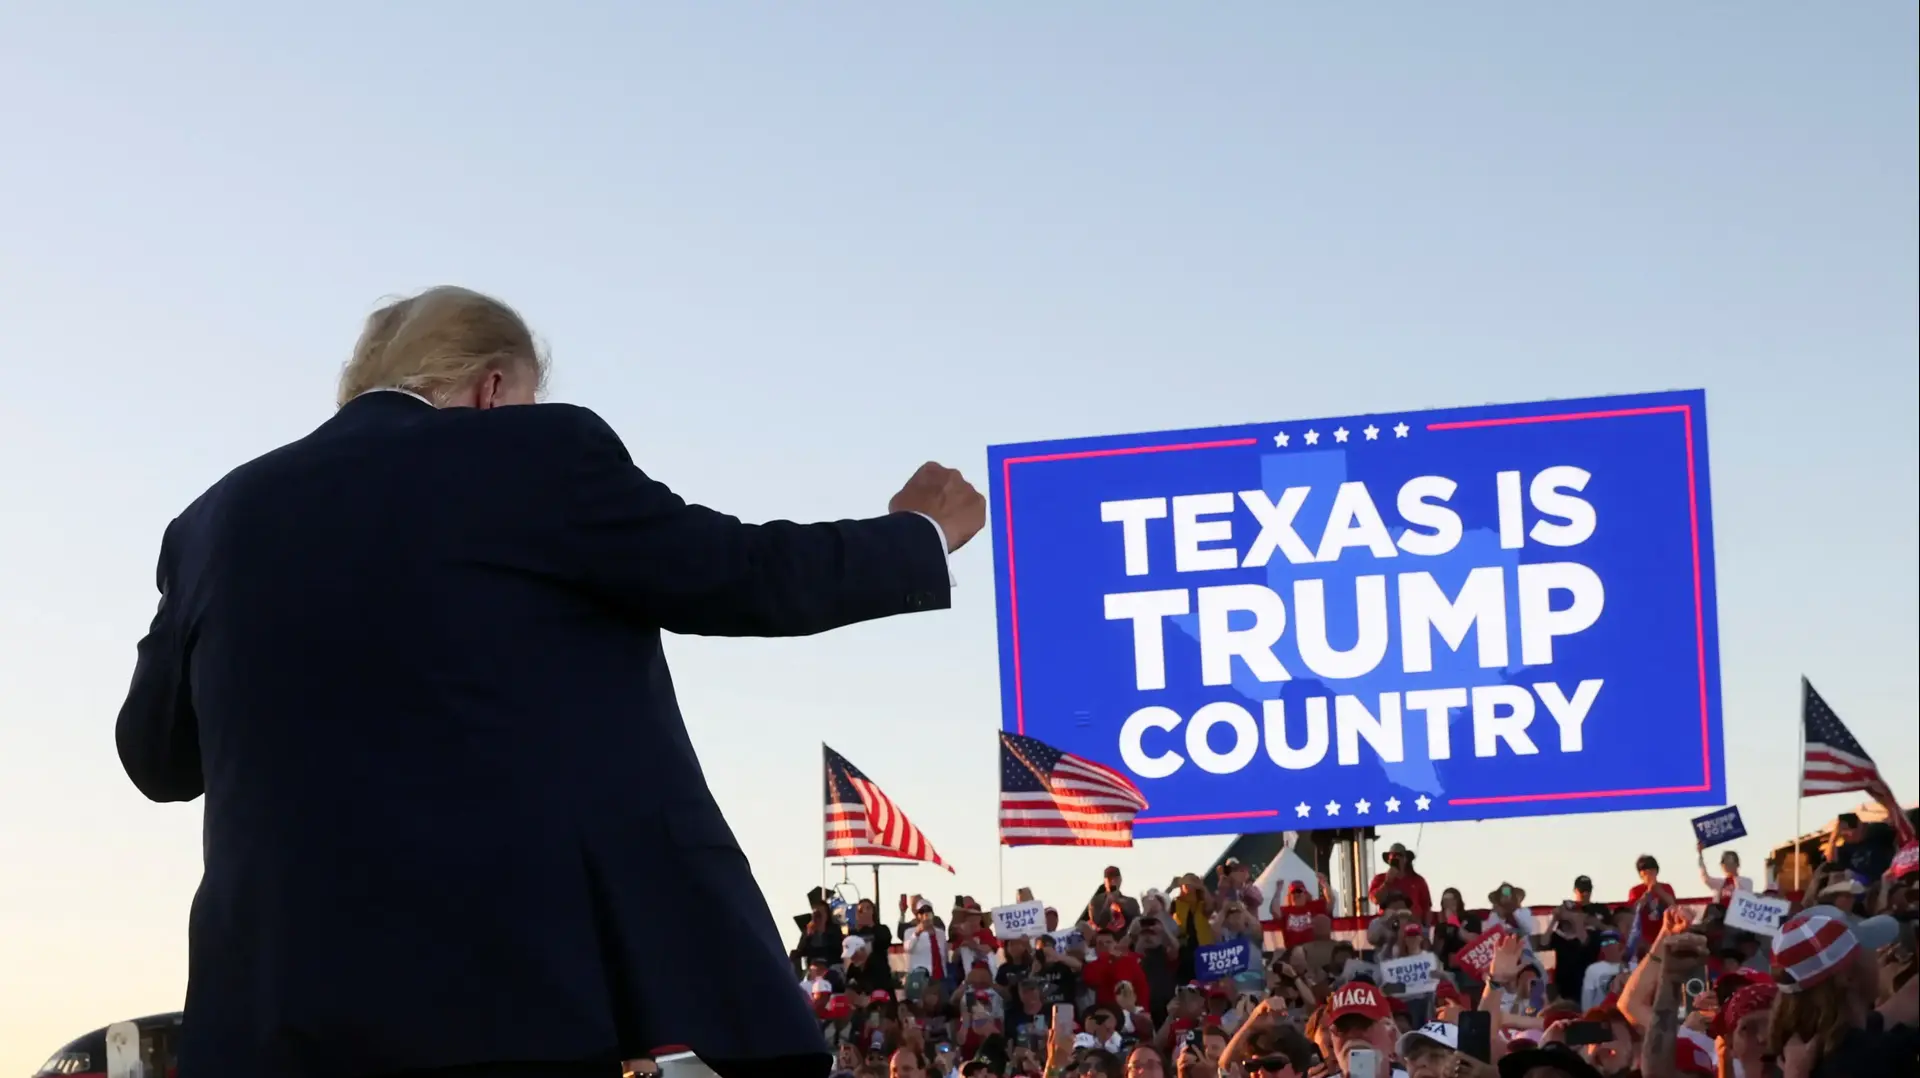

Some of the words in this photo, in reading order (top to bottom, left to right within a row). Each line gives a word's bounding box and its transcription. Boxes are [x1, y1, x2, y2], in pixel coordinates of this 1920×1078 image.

[1101, 475, 1463, 576] TEXAS
[1496, 465, 1597, 550] IS
[1103, 561, 1605, 691] TRUMP
[1118, 678, 1604, 779] COUNTRY
[1696, 812, 1736, 832] TRUMP
[997, 907, 1039, 921] TRUMP
[1738, 898, 1782, 914] TRUMP
[1005, 917, 1035, 929] 2024
[1740, 908, 1772, 923] 2024
[1200, 945, 1244, 963] TRUMP
[1208, 956, 1239, 971] 2024
[1387, 961, 1430, 977] TRUMP
[1332, 988, 1377, 1010] MAGA
